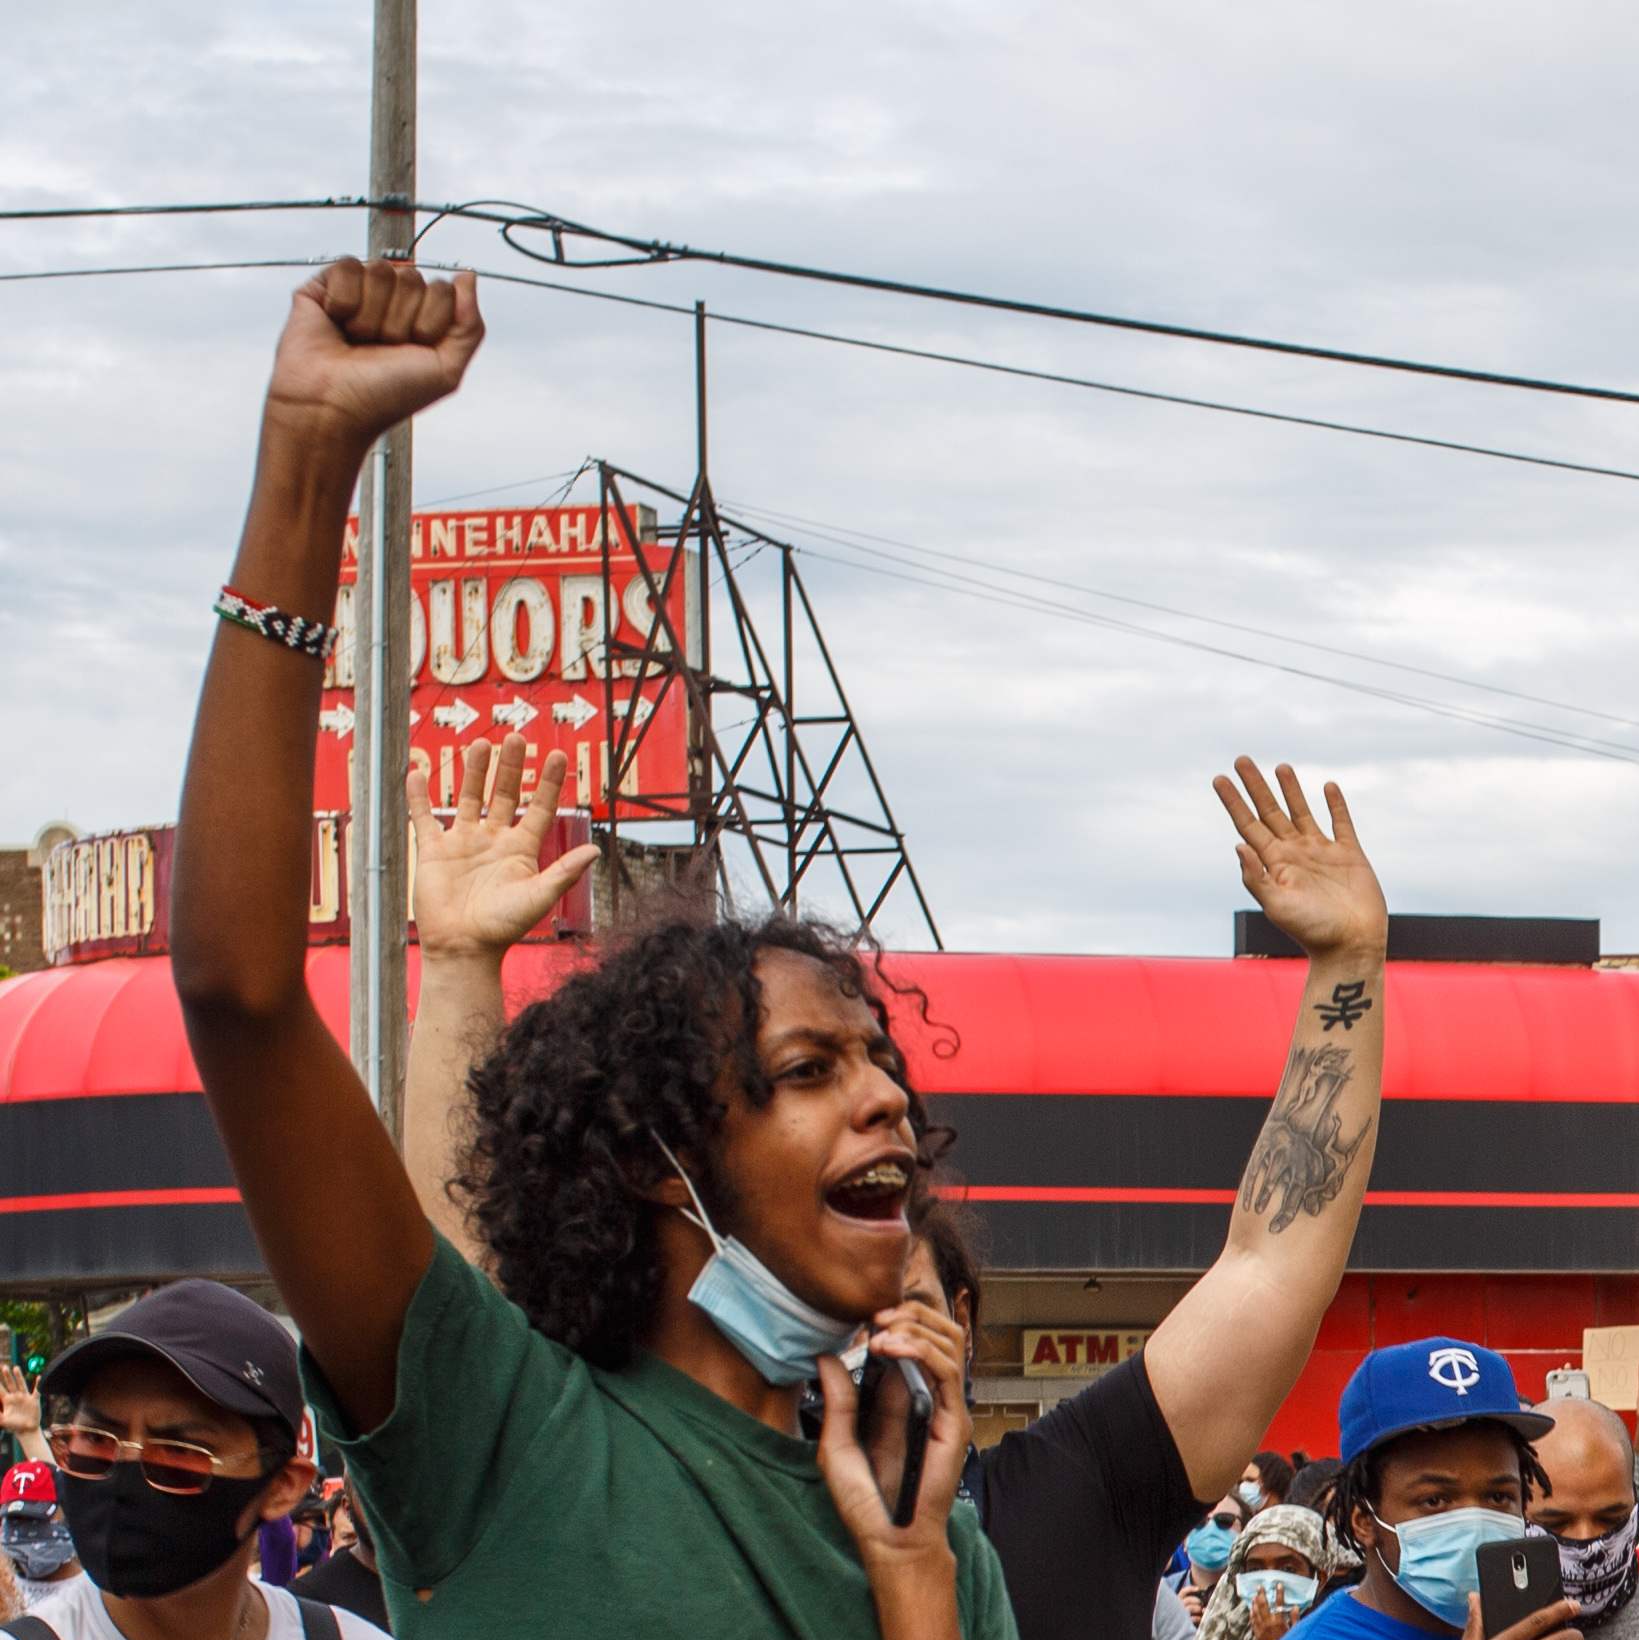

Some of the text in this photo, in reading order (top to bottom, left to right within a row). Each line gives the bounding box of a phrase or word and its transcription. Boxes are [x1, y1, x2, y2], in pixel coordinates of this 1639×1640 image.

[344, 510, 622, 561] NEHAHA
[325, 572, 675, 689] IUORS
[1031, 1335, 1119, 1364] ATM
[13, 1472, 36, 1495] T
